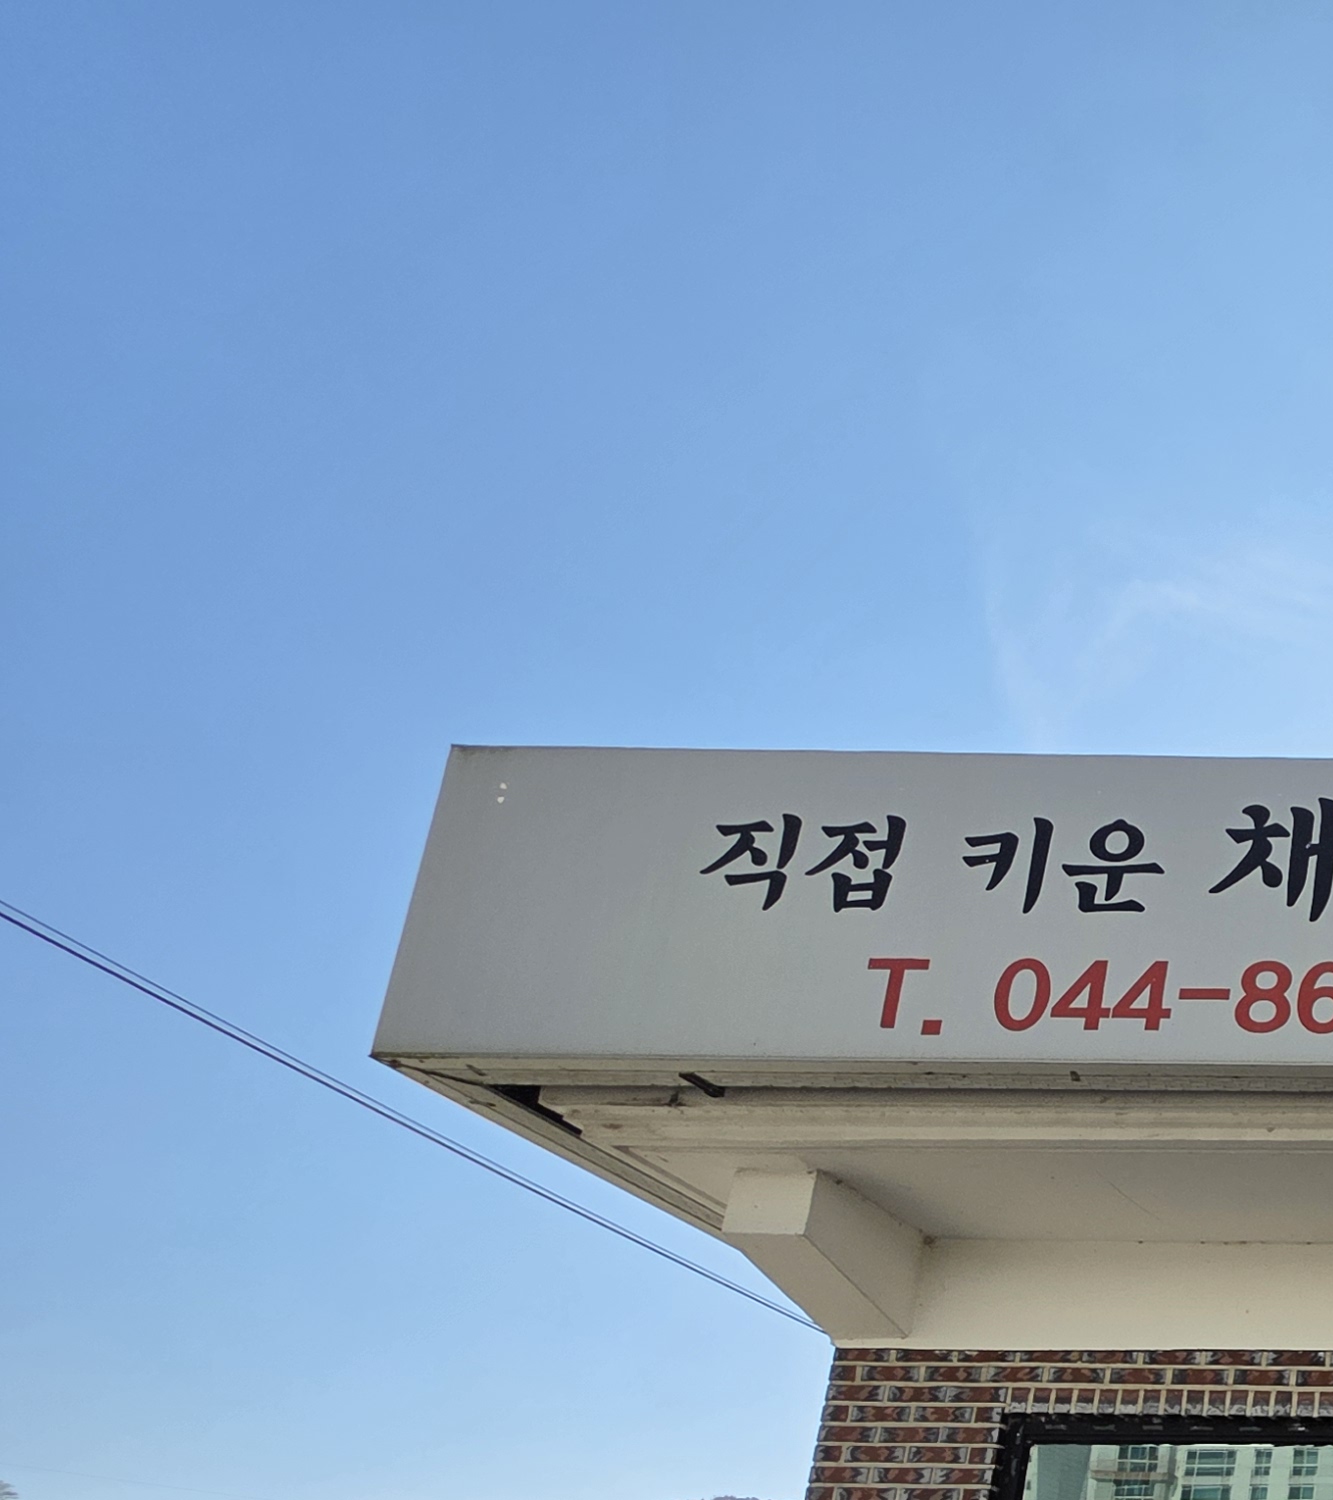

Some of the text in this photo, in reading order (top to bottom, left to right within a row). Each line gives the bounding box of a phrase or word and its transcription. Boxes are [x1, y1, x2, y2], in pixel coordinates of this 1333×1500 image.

[700, 814, 907, 912] 직접
[963, 818, 1165, 914] 키운
[866, 958, 942, 1036] T.
